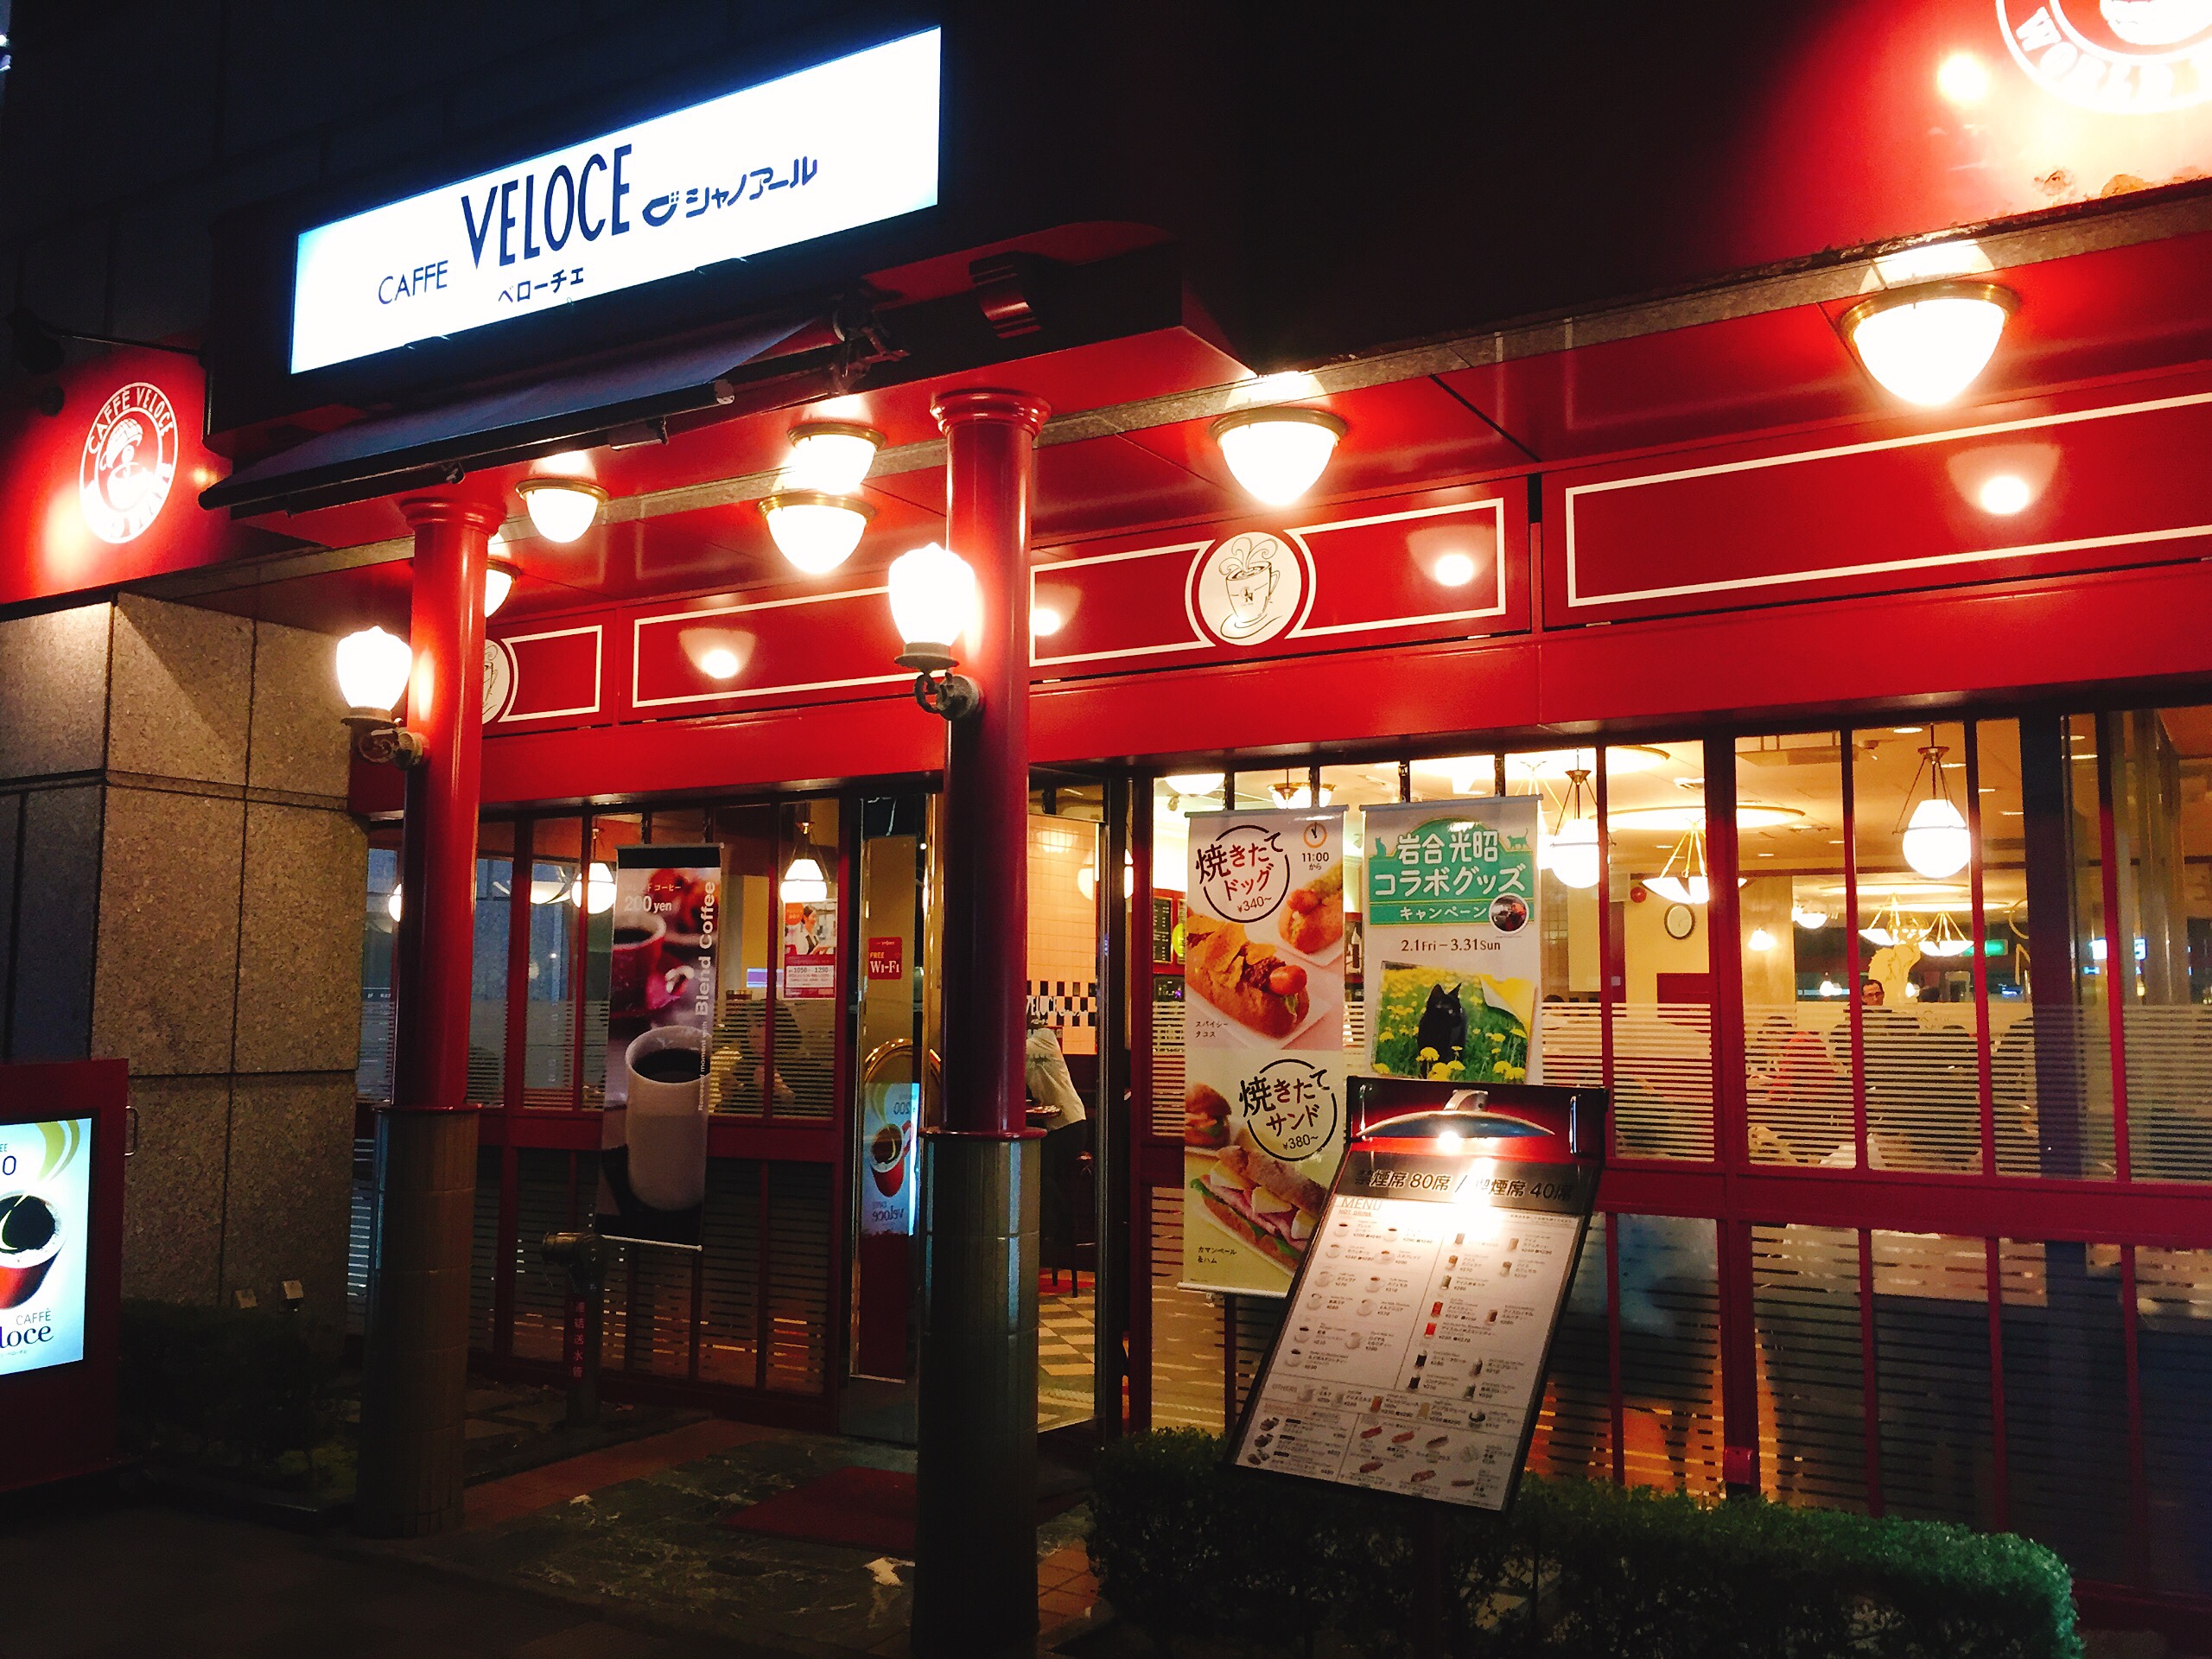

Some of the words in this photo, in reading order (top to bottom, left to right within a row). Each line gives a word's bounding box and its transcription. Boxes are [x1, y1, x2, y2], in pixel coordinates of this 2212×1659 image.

[685, 156, 818, 218] シャノアール
[378, 259, 448, 304] CAFFE
[460, 143, 633, 270] VELOCE
[497, 267, 585, 304] ベローチェ
[88, 390, 130, 454] CAFFE
[137, 387, 174, 437] VELOCE
[1195, 831, 1285, 885] 焼きたて
[1301, 851, 1330, 862] 11:00
[1308, 862, 1322, 871] から
[1224, 862, 1274, 901] ドッグ
[1374, 862, 1526, 897] コラボグッズ
[653, 900, 672, 914] yen
[699, 881, 716, 949] Coffee
[1400, 906, 1487, 921] キャンペーン
[869, 960, 900, 974] Wi-Fi
[695, 956, 712, 1016] Blend
[1195, 1020, 1229, 1028] スパイシー
[1238, 1069, 1331, 1117] 焼きたて
[1266, 1103, 1320, 1137] サンド
[1409, 1173, 1452, 1192] 80席
[1341, 1198, 1382, 1211] MENU
[16, 1307, 52, 1325] CAFFÈ
